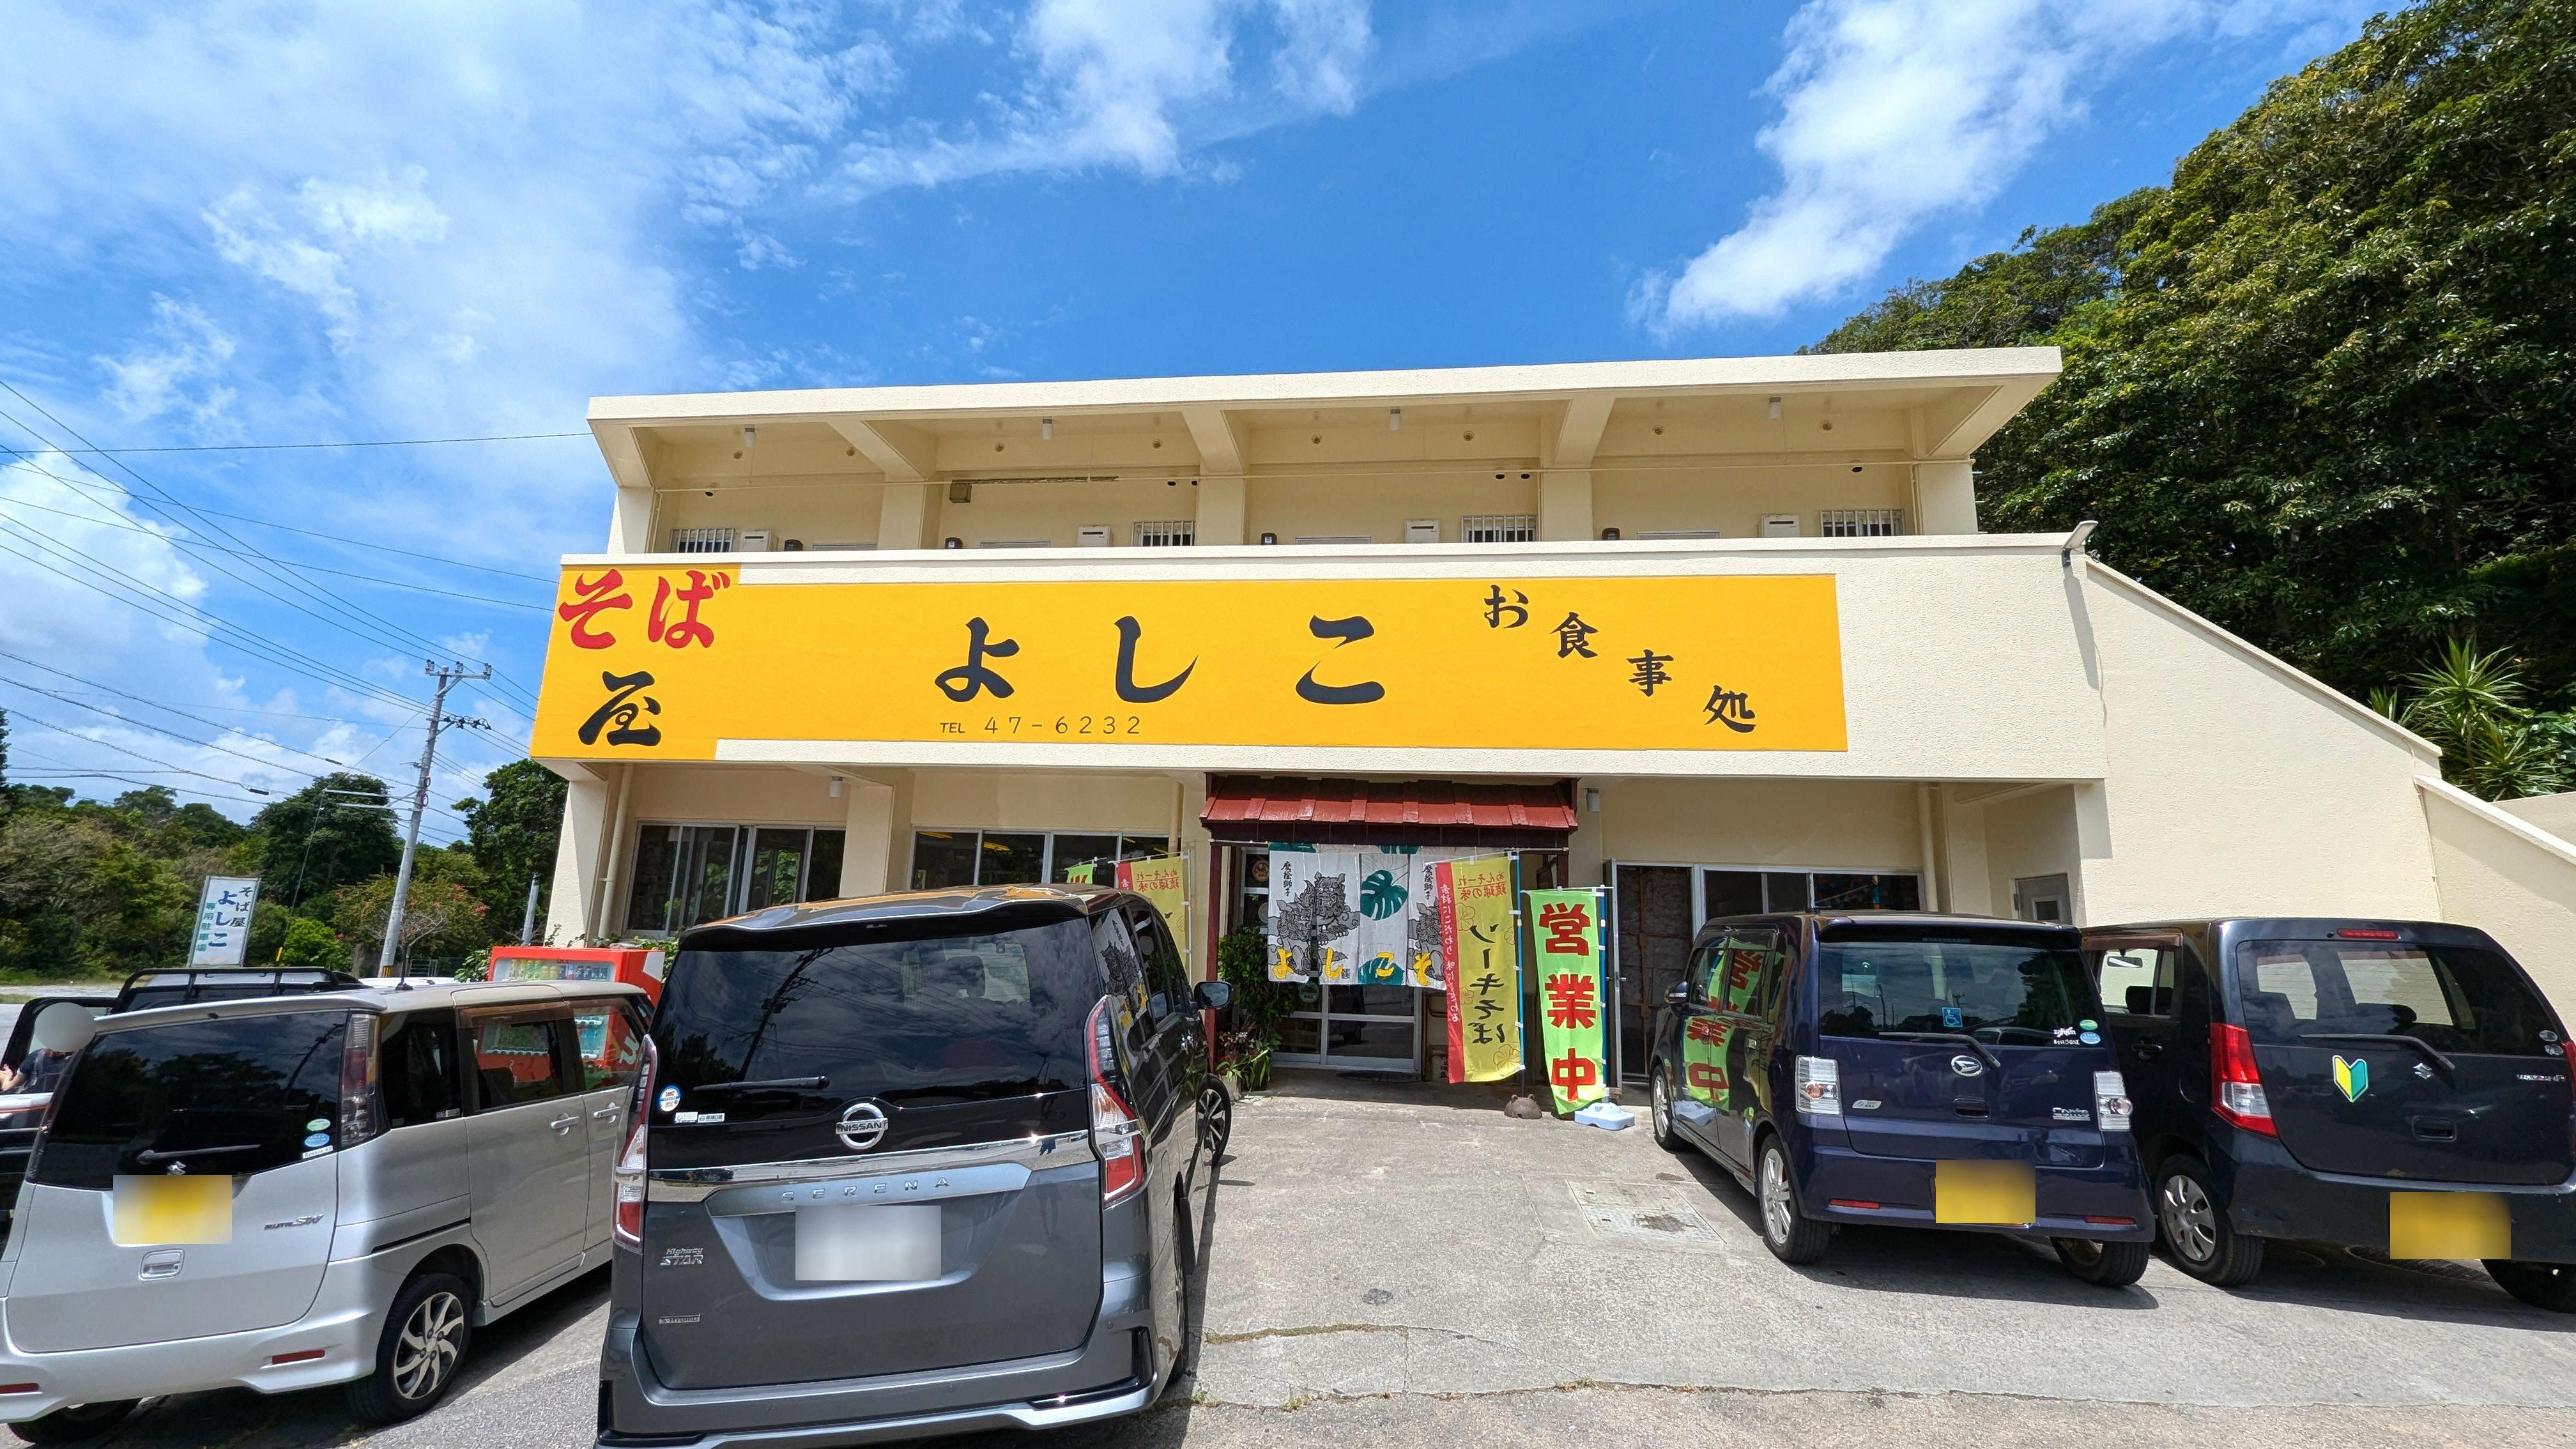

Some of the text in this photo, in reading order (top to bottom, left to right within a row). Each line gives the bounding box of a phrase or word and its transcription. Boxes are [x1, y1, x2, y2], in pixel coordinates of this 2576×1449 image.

[560, 569, 730, 650] そば
[935, 616, 1386, 705] よしこ
[1484, 585, 1756, 733] お食事処
[578, 671, 662, 747] 屋
[940, 716, 1140, 735] TEL 47-6232
[208, 890, 238, 947] よしこ
[228, 886, 253, 928] そば屋
[1538, 902, 1597, 1102] 営業中
[840, 1121, 882, 1132] NISSAN
[781, 1177, 949, 1204] SERENA
[660, 1254, 703, 1266] STAR
[666, 1248, 703, 1256] Highway
